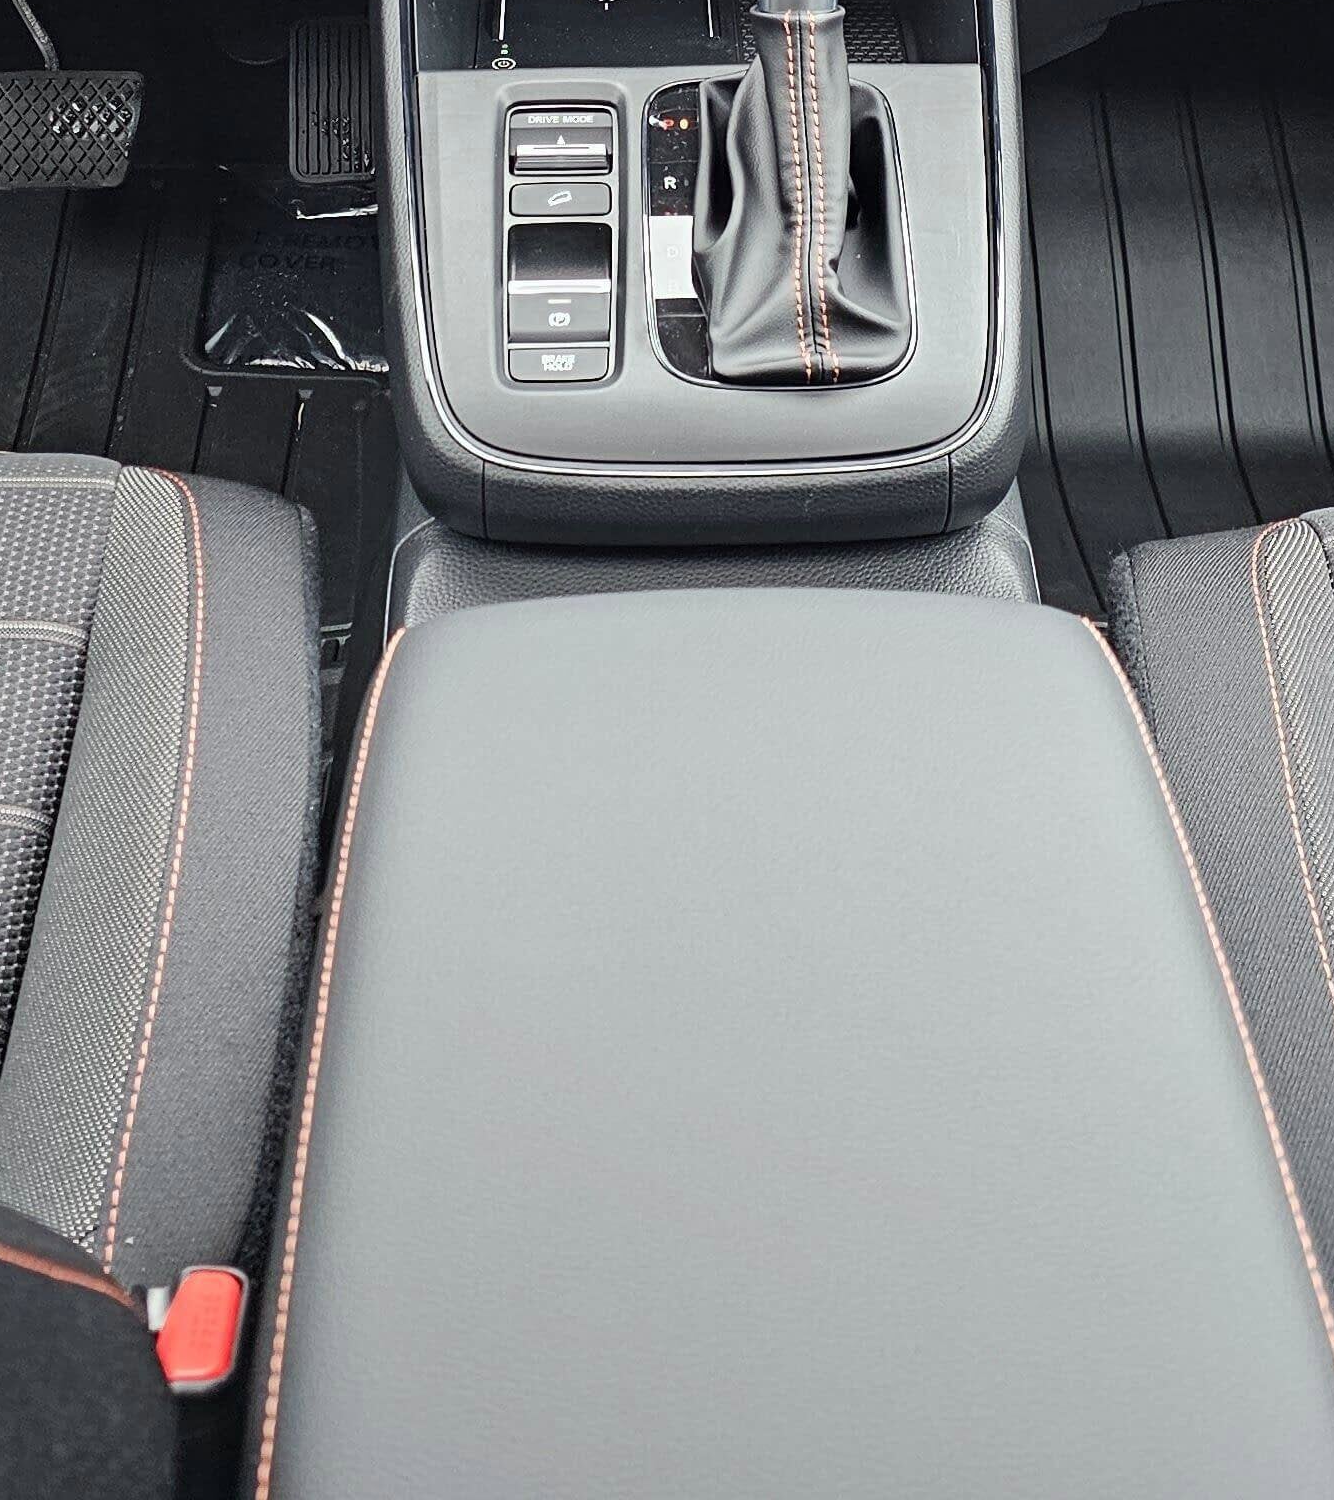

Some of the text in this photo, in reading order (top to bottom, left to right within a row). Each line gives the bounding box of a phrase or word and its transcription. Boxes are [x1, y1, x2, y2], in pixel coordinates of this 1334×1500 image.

[527, 115, 594, 124] DRIVE MODE
[663, 176, 677, 190] R
